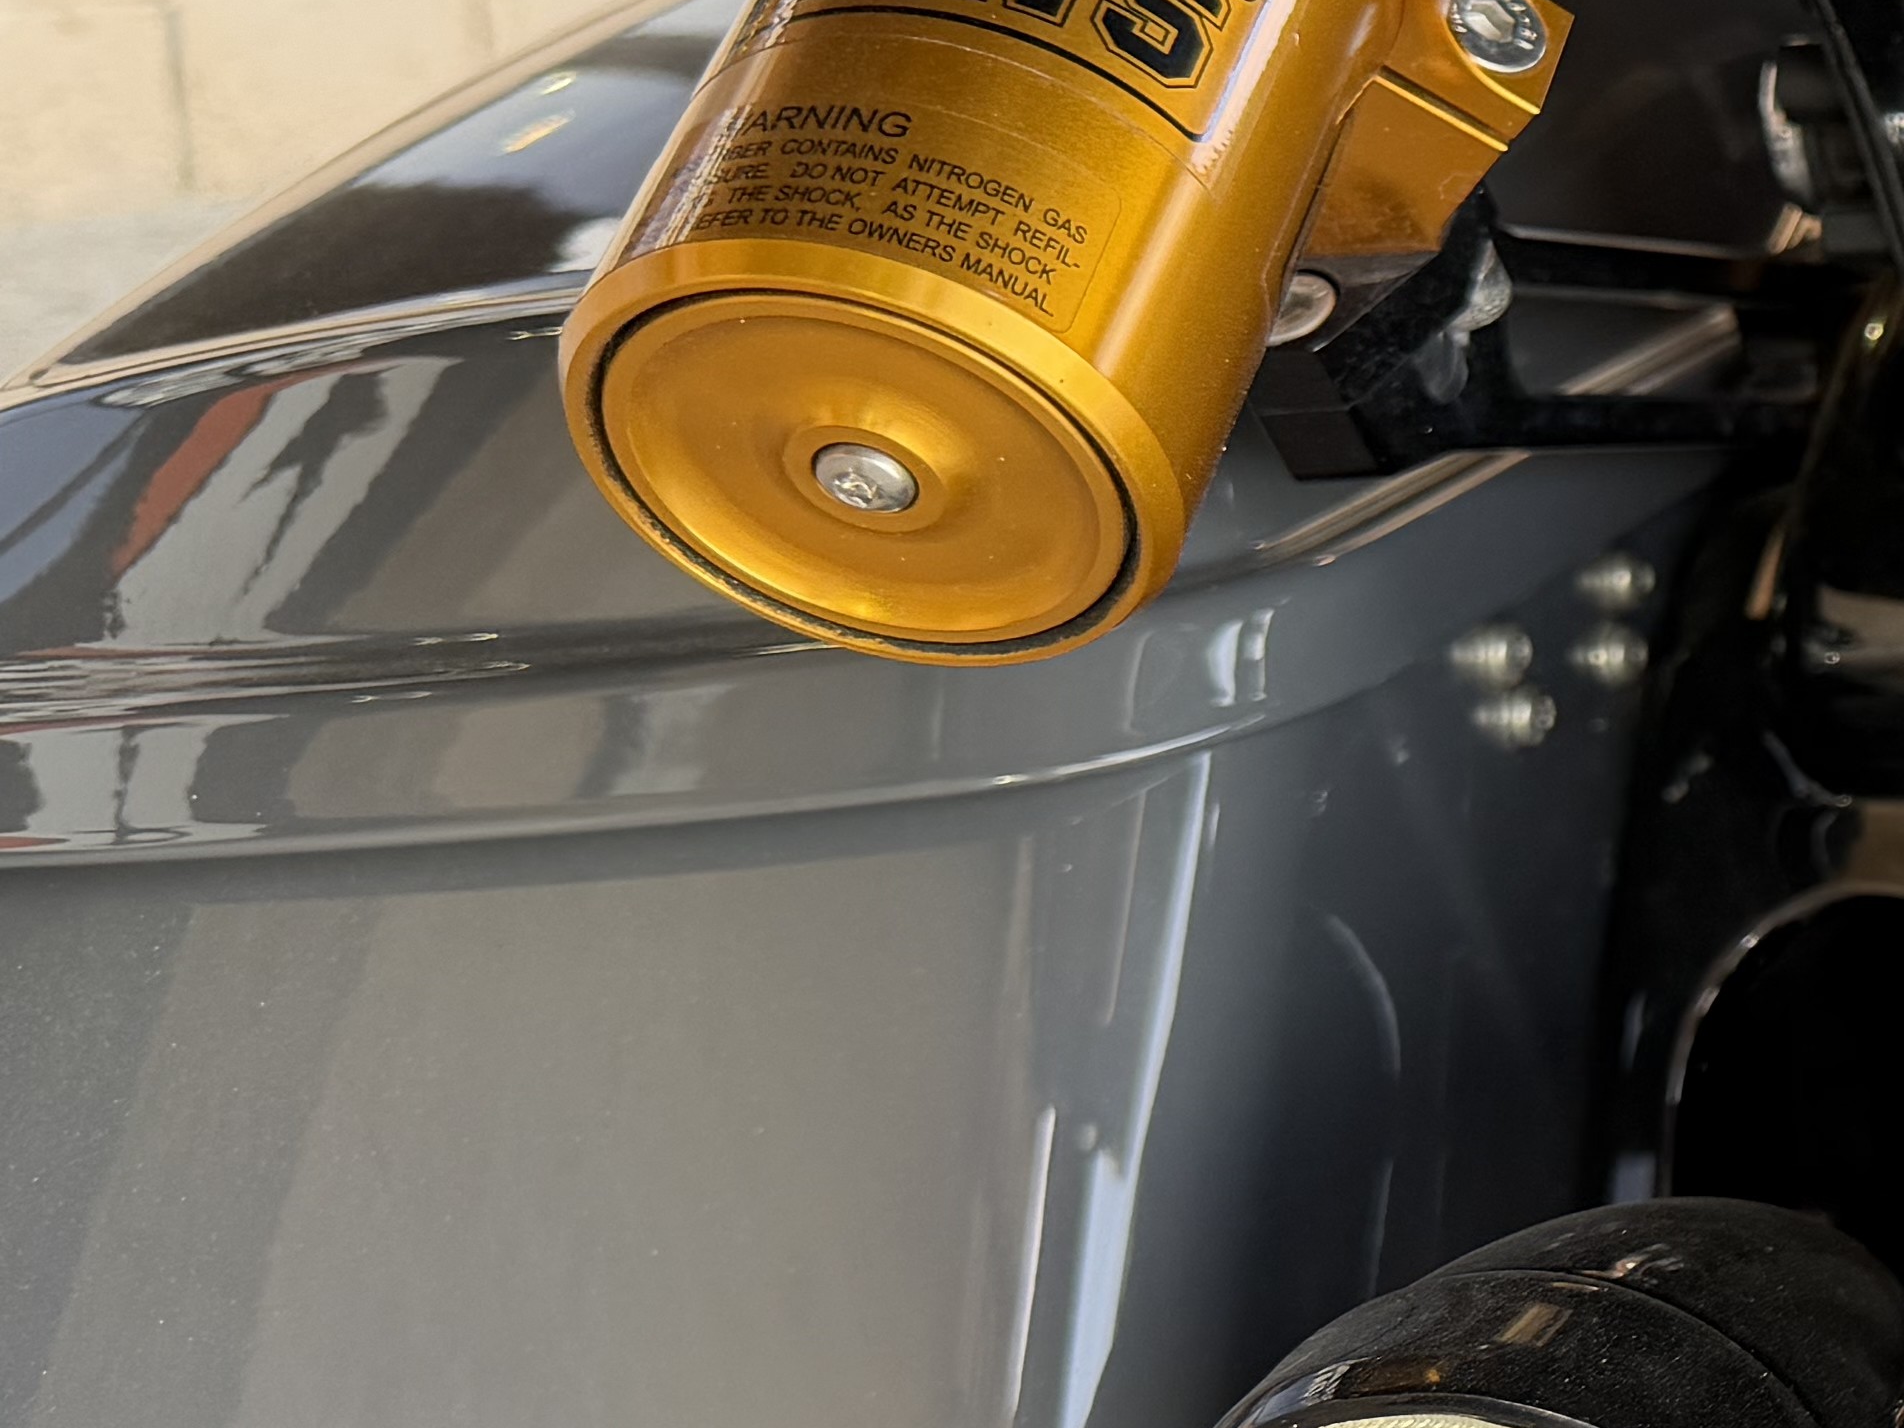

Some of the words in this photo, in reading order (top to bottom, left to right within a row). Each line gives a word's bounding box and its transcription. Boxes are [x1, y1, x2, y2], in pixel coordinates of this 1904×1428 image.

[728, 103, 913, 139] ARNING
[728, 185, 771, 204] THE
[774, 185, 861, 212] SHOCK,
[882, 200, 916, 222] AS
[926, 209, 972, 241] THE
[976, 232, 1057, 285] SHOCK
[780, 138, 899, 164] CONTAINS
[908, 153, 1035, 213] NITROGEN
[1043, 208, 1089, 245] GAS
[789, 161, 828, 180] DO
[832, 166, 887, 187] NOT
[892, 177, 1005, 226] ATTEMPT
[1013, 221, 1081, 269] REFIL-
[761, 208, 789, 226] TO
[794, 209, 843, 232] THE
[848, 217, 955, 263] OWNERS
[961, 252, 1055, 318] MANUAL
